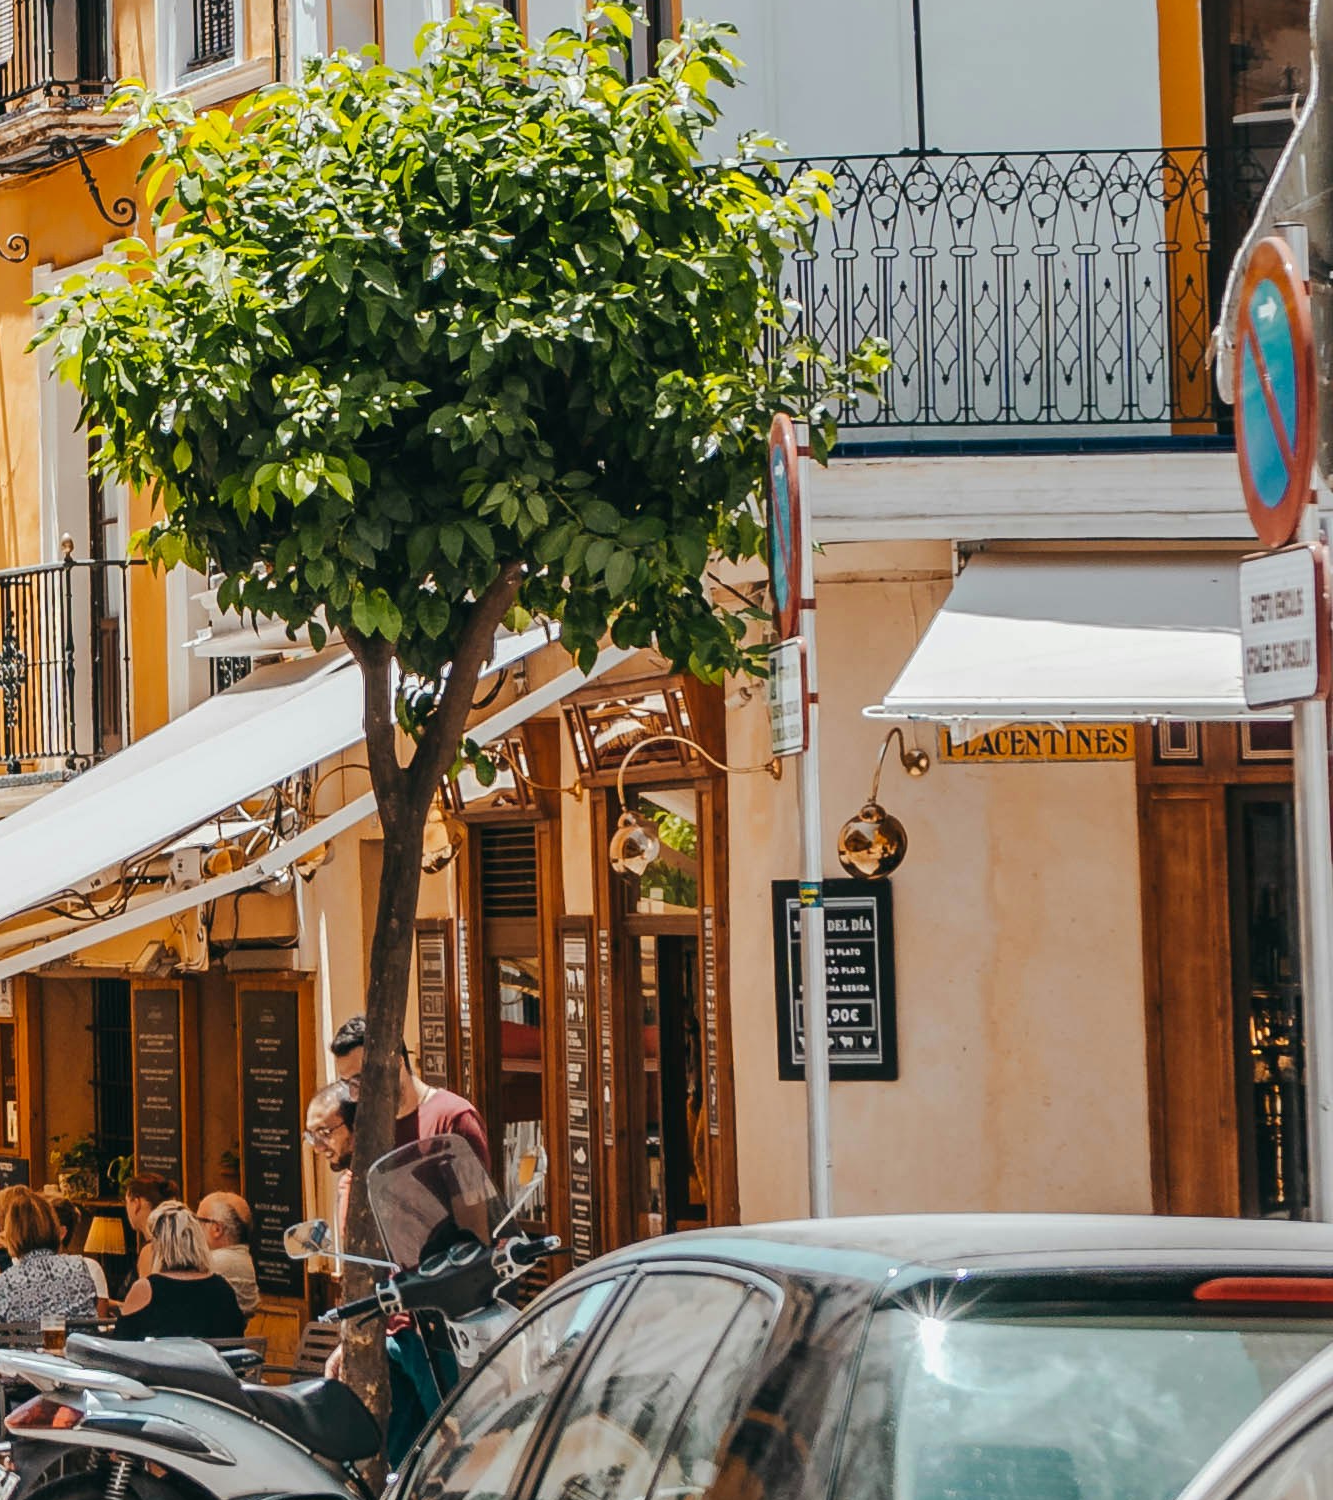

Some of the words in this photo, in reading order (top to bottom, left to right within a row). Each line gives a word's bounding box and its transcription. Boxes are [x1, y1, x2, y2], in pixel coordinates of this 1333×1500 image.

[827, 919, 850, 932] DEL
[836, 948, 861, 956] PLATO
[841, 966, 866, 975] PLATO
[827, 1008, 860, 1025] ,90€
